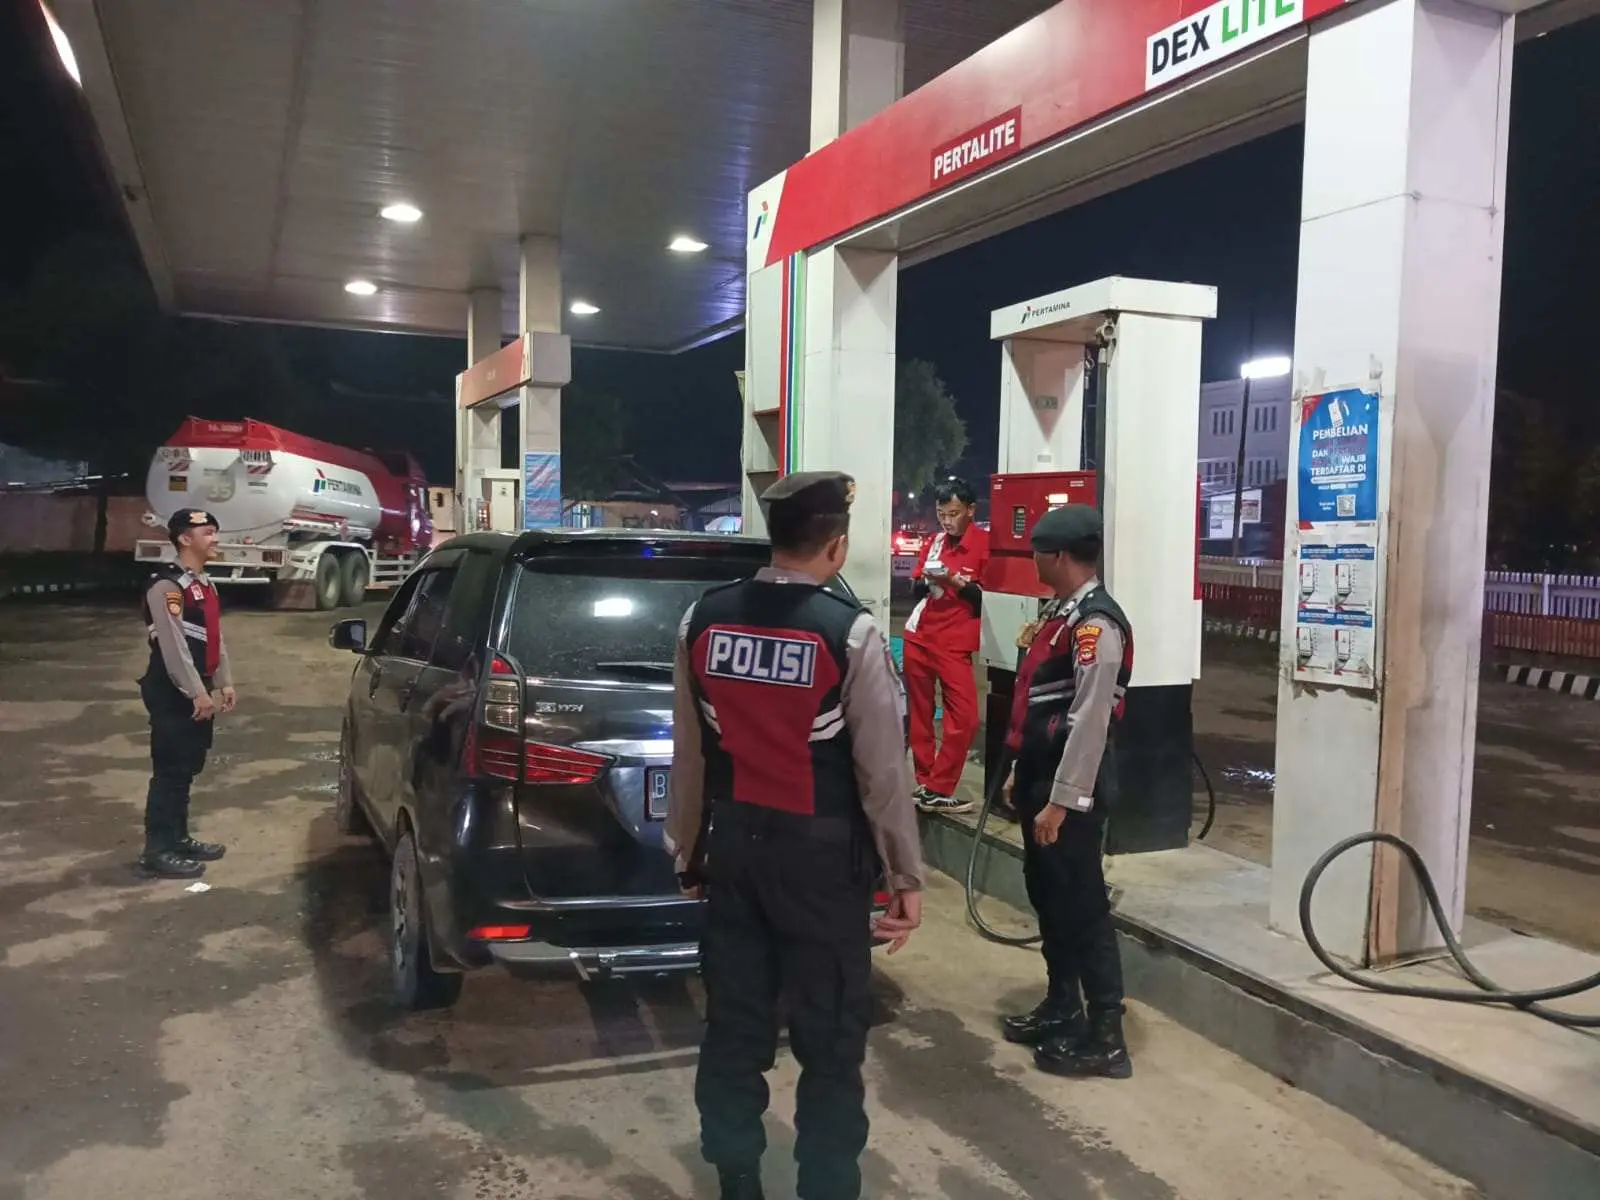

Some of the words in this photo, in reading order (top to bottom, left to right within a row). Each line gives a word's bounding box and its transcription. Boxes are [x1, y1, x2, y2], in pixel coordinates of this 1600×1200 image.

[1151, 14, 1210, 76] DEX
[932, 118, 1017, 181] PERTALITE
[1031, 300, 1071, 317] PERTAMINA
[1312, 423, 1369, 441] PEMBELIAN
[1311, 465, 1356, 477] TERDAFTAR
[1357, 463, 1366, 474] DI
[710, 635, 811, 683] POLISI
[655, 773, 666, 798] B
